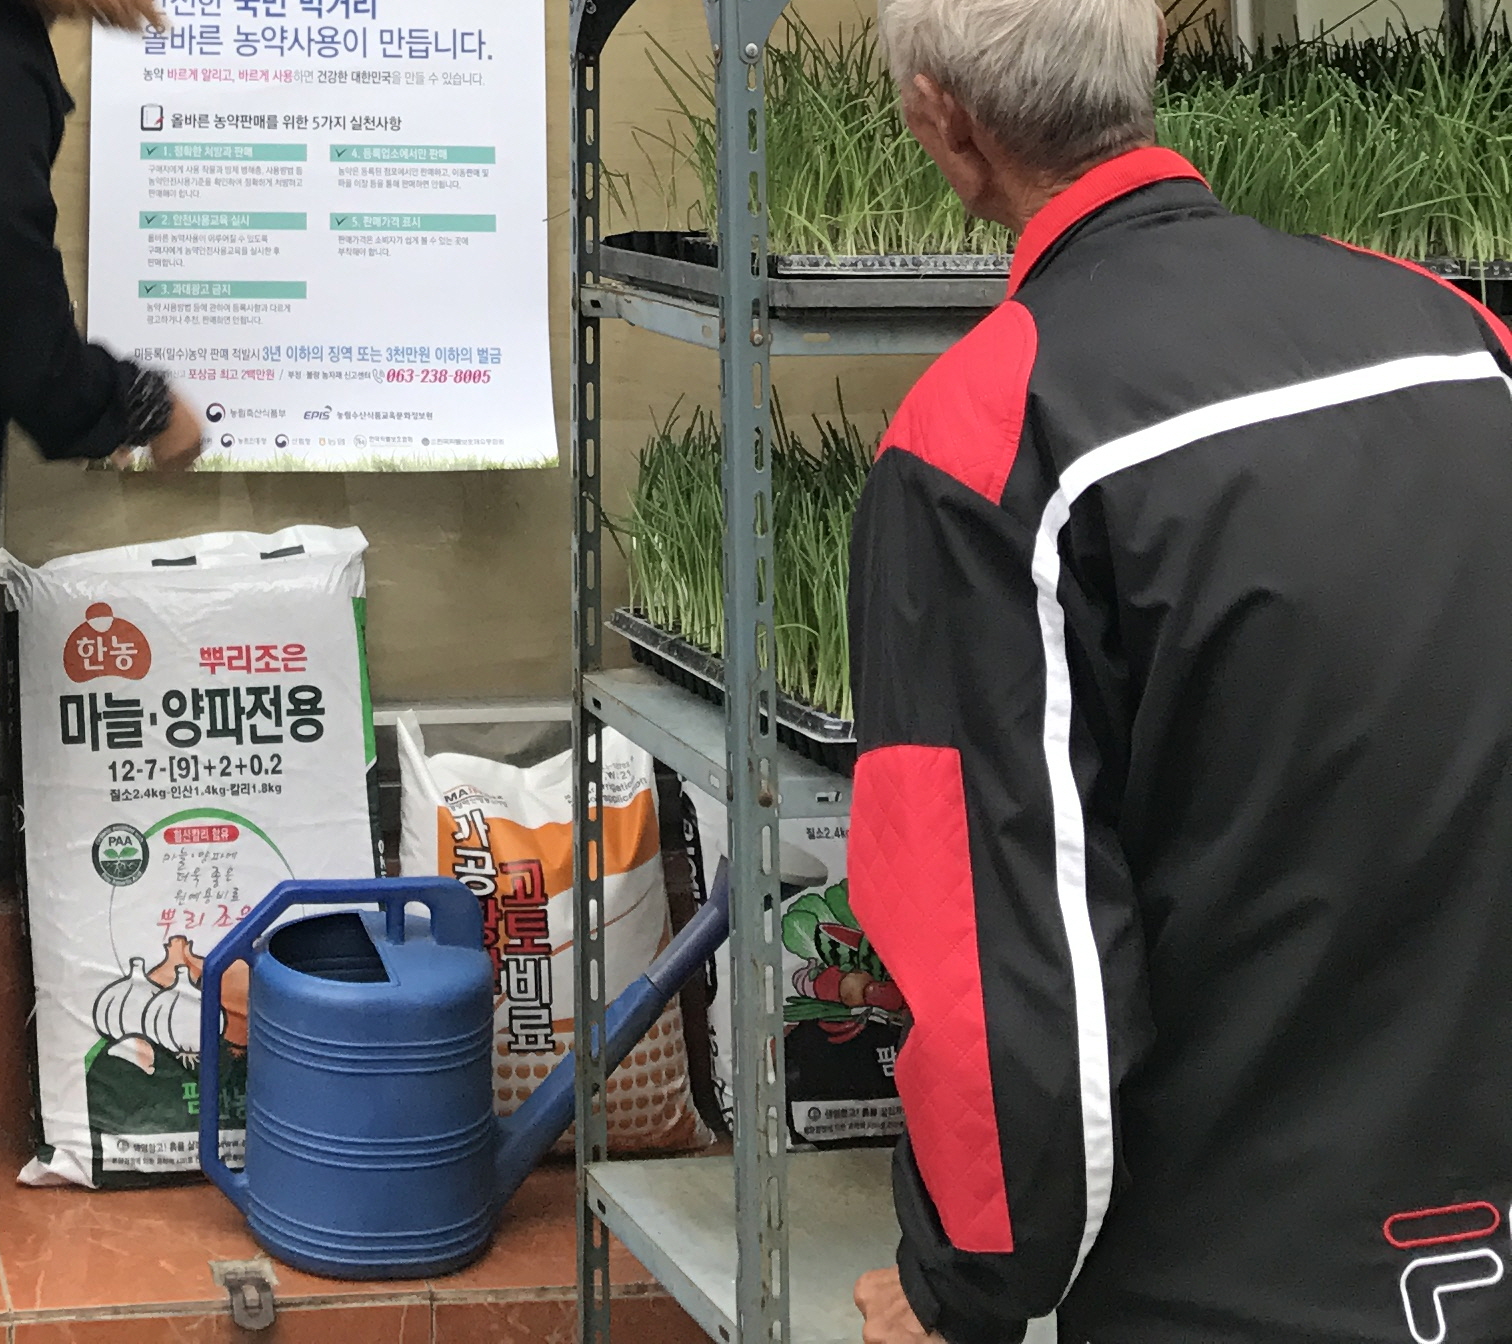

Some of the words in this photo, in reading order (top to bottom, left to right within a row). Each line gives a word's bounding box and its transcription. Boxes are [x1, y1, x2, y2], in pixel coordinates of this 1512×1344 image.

[142, 23, 224, 56] 올바른
[233, 24, 369, 59] 농약사용이
[380, 27, 494, 61] 만듭니다.
[143, 67, 164, 82] 농약
[167, 67, 198, 82] 바르게
[201, 68, 235, 83] 알리고,
[238, 68, 270, 83] 바르게
[272, 69, 314, 84] 사용하면
[317, 69, 348, 84] 건강한
[351, 70, 402, 85] 대한민국을
[404, 70, 426, 85] 만들
[428, 71, 439, 86] 수
[442, 71, 486, 86] 있습니다.
[171, 113, 211, 130] 올바른
[213, 114, 279, 131] 농약판매를
[282, 114, 309, 131] 위한
[312, 115, 347, 132] 5가지
[350, 115, 403, 132] 실천사항
[234, 146, 254, 158] 판매
[429, 148, 448, 160] 판매
[231, 214, 250, 226] 실시
[362, 216, 400, 228] 판매가격
[401, 216, 421, 228] 표시
[172, 284, 210, 296] 과대광고
[210, 348, 229, 361] 판매
[231, 348, 260, 361] 적발시
[262, 345, 281, 362] 3년
[287, 345, 324, 362] 이하의
[328, 345, 353, 362] 징역
[357, 346, 382, 363] 또는
[386, 346, 431, 363] 3천만원
[435, 347, 473, 364] 이하의
[477, 347, 502, 365] 벌금
[188, 368, 217, 381] 포상금
[220, 368, 238, 381] 최고
[241, 368, 275, 381] 2백만원
[386, 368, 492, 384] 063-238-8005
[303, 410, 331, 421] EPIS
[76, 635, 139, 672] 한농
[199, 643, 308, 675] 뿌리조은
[107, 752, 283, 784] 12-7-[9]+2+0.2
[108, 835, 134, 848] PAA
[176, 867, 202, 888] 더욱
[210, 866, 235, 888] 좋은
[174, 887, 241, 906] 원예용비료
[498, 858, 556, 1055] 고토비료
